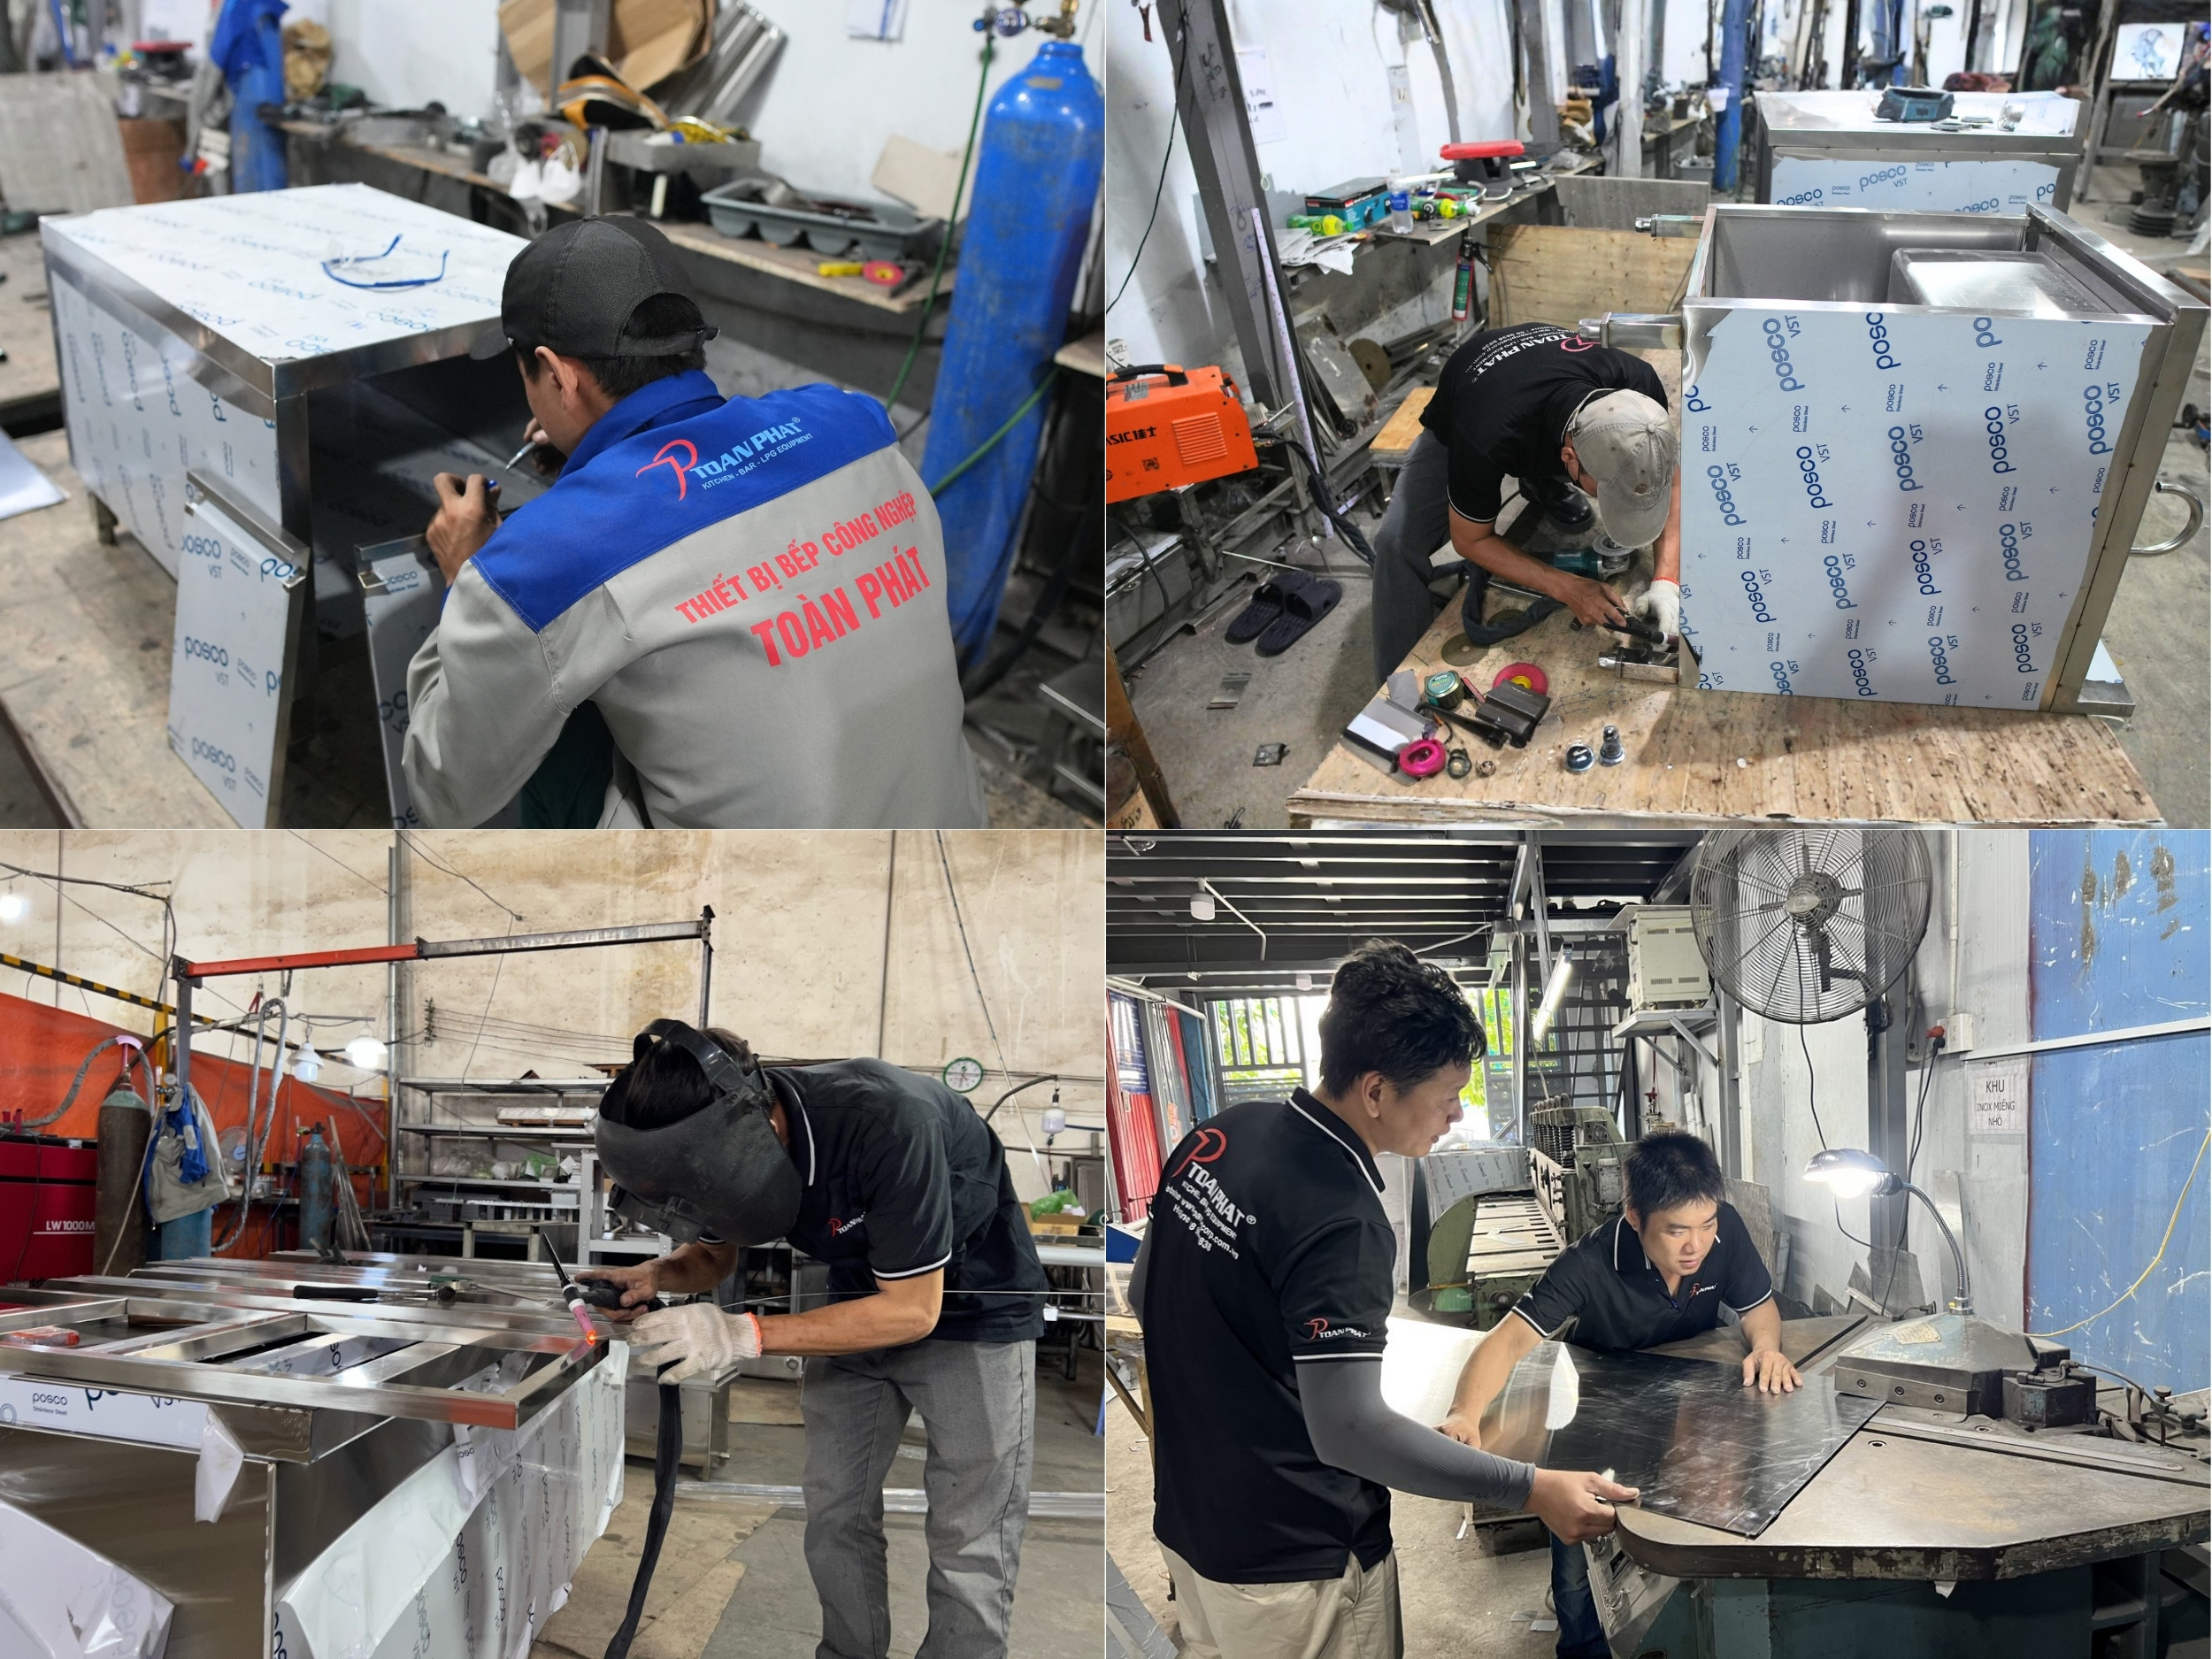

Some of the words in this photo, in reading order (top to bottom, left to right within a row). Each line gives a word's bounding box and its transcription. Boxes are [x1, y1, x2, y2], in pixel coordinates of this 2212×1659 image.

[1859, 165, 1906, 192] posco
[1893, 178, 1908, 188] VST
[1785, 315, 1801, 338] VST
[1520, 334, 1571, 349] TOAN
[1866, 313, 1901, 369] posc
[1763, 319, 1805, 391] posco
[2085, 340, 2098, 370] posco
[1984, 363, 1995, 392] posco
[1886, 384, 1895, 411] posco
[2108, 382, 2120, 403] VST
[1793, 405, 1801, 432] posco
[2007, 404, 2019, 424] VST
[2084, 386, 2113, 455] posco
[1702, 426, 1711, 451] posco
[1909, 424, 1923, 444] VST
[1985, 407, 2016, 473] posco
[689, 441, 754, 479] TOAN
[703, 474, 734, 489] KITCHEN
[739, 463, 757, 476] BAR
[760, 450, 777, 463] LPG
[777, 433, 813, 453] EQUIPMENT
[1816, 443, 1830, 462] VST
[1888, 426, 1924, 491] posco
[1726, 462, 1741, 481] VST
[1796, 447, 1833, 508] posco
[2093, 468, 2105, 493] posco
[1707, 465, 1747, 526] posco
[1999, 487, 2009, 511] posco
[1909, 503, 1917, 527] posco
[2020, 522, 2032, 540] VST
[1931, 538, 1942, 555] VST
[1999, 524, 2029, 581] posco
[675, 572, 749, 624] THIẾT
[746, 561, 784, 593] BỊ
[774, 539, 819, 579] BẾP
[821, 512, 879, 556] CÔNG
[1842, 553, 1855, 570] VST
[1910, 541, 1941, 595] posco
[1759, 569, 1772, 585] VST
[1824, 556, 1857, 609] posco
[750, 587, 861, 667] TOÀN
[855, 545, 931, 619] PHÁT
[1741, 572, 1777, 622] posco
[2011, 592, 2022, 613] posco
[1927, 606, 1936, 626] posco
[1947, 635, 1958, 649] VST
[2032, 622, 2042, 637] VST
[185, 636, 228, 666] posco
[1865, 648, 1877, 662] VST
[1928, 637, 1956, 685] posco
[2011, 624, 2038, 672] posco
[1712, 672, 1724, 685] VST
[1770, 662, 1793, 695] osco
[1787, 660, 1799, 674] VST
[1847, 649, 1878, 696] posco
[2022, 682, 2032, 701] posco
[192, 738, 235, 772] posco
[1986, 1079, 2004, 1093] KHU
[1977, 1102, 1992, 1111] INOX
[33, 1393, 67, 1405] posco
[34, 1405, 54, 1414] Stainless
[457, 1532, 467, 1584] osco
[495, 1567, 505, 1621] posco
